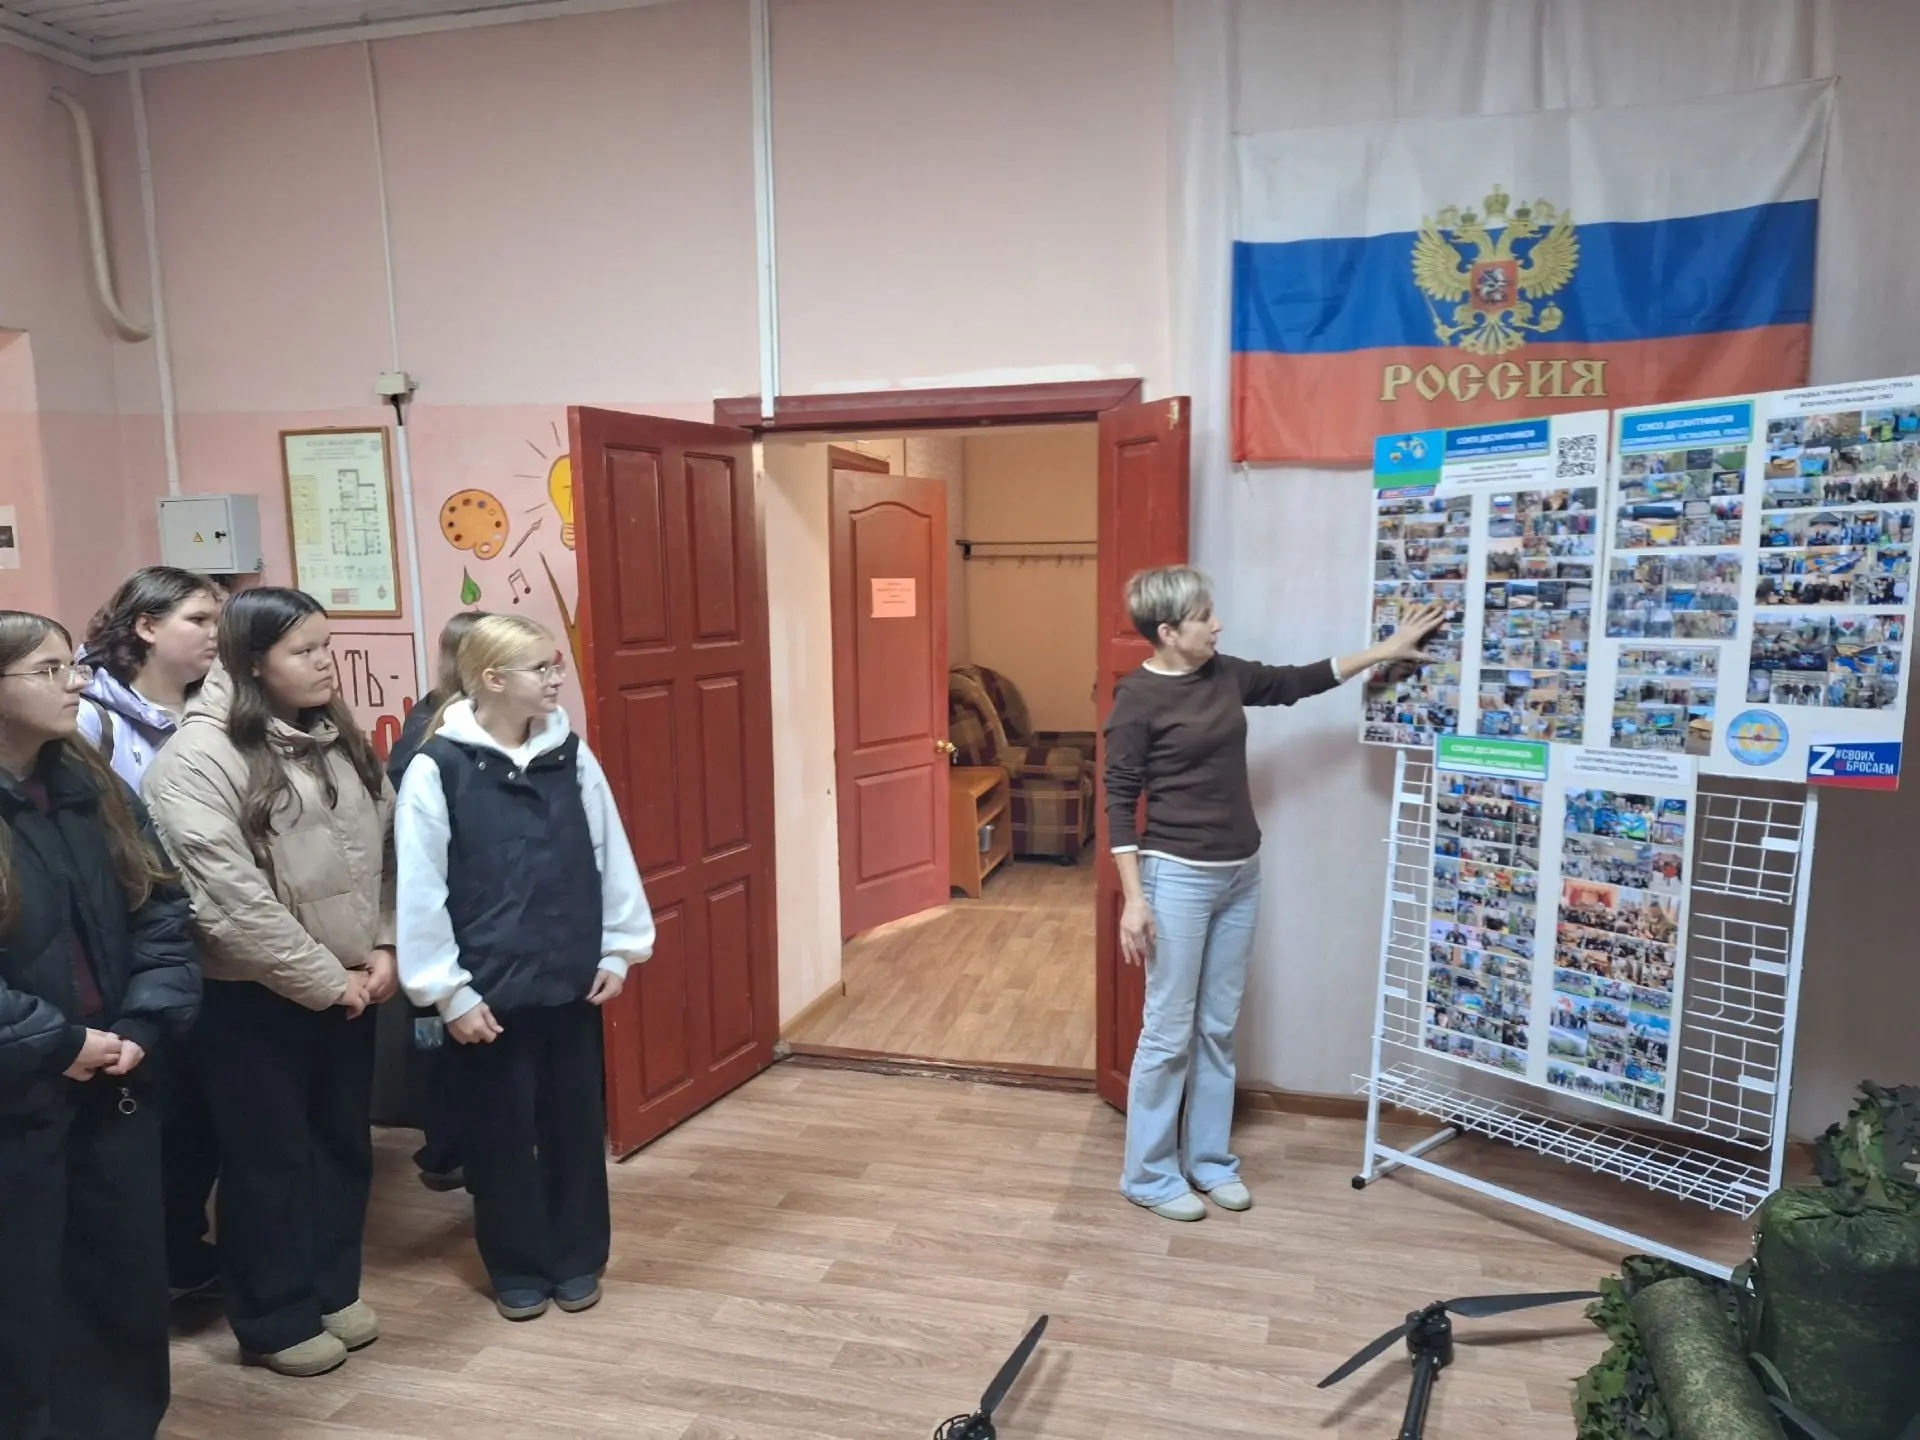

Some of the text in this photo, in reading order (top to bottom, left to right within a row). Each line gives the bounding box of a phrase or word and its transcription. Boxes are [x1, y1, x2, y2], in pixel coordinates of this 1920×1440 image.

[1380, 359, 1608, 402] РОССИЯ
[1809, 745, 1836, 776] Z
[1835, 749, 1875, 762] #СВОИХ
[1846, 760, 1894, 775] БРОСАЕМ
